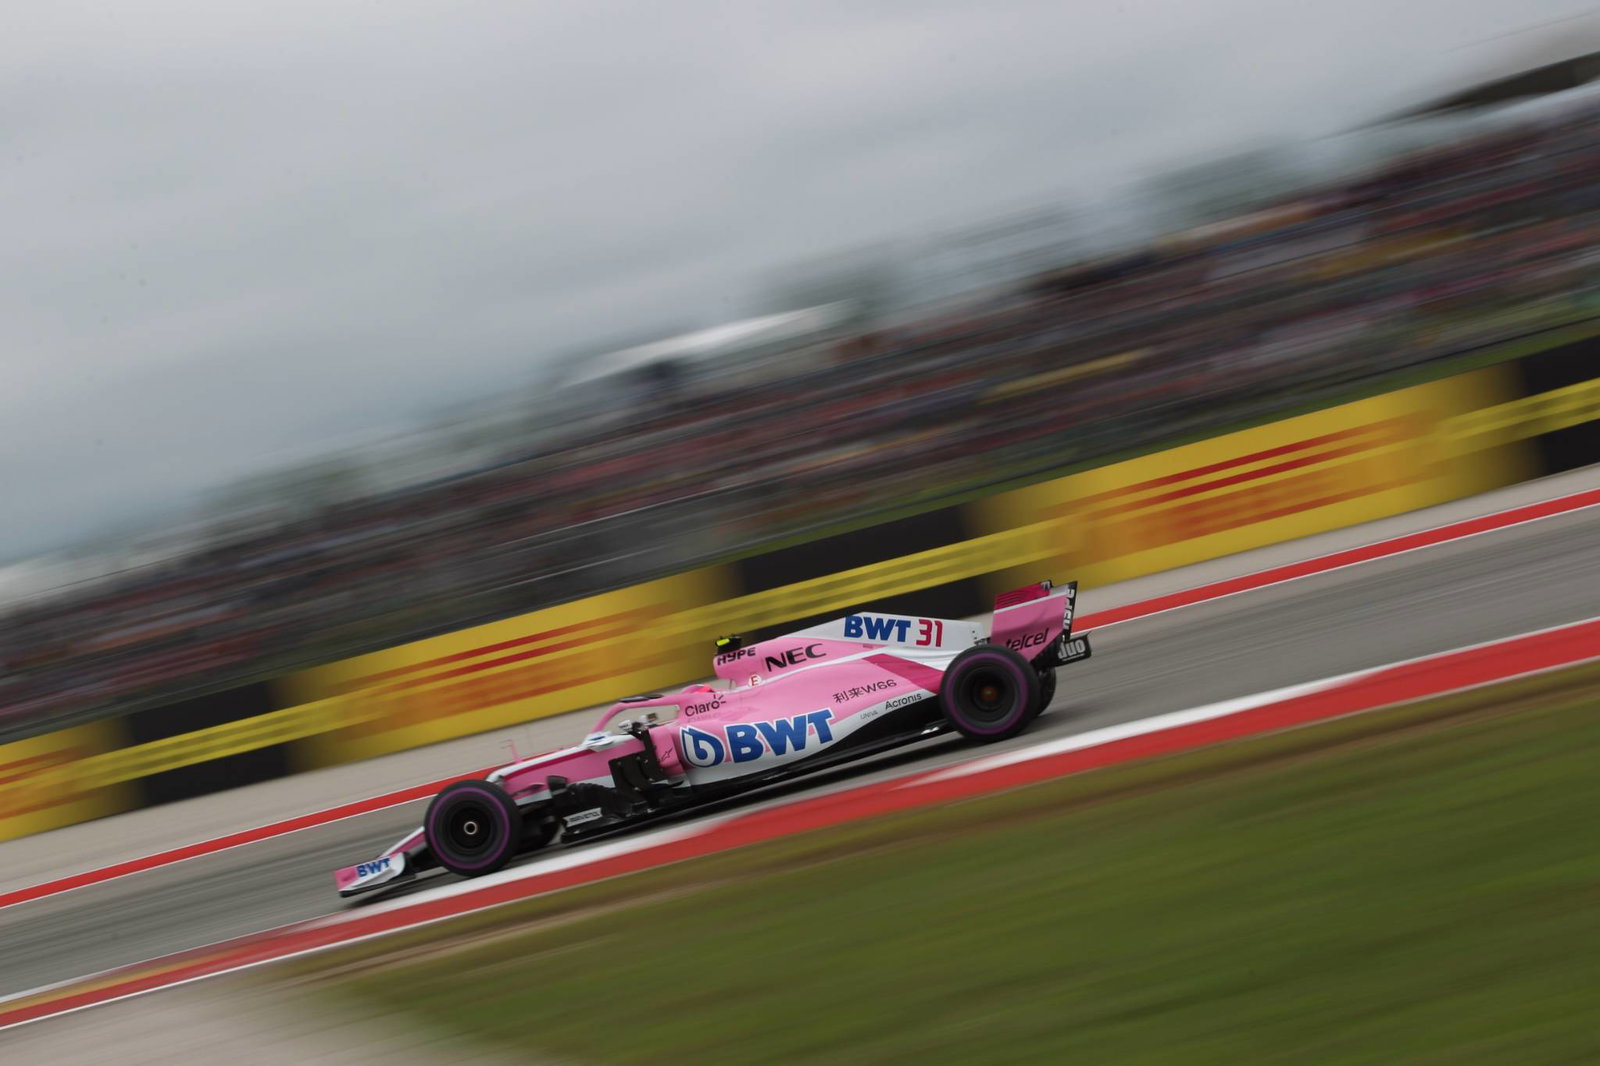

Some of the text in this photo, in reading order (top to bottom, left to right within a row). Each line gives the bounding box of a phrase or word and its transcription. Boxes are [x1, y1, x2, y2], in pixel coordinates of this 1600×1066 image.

[843, 616, 943, 647] BWT 31
[1006, 627, 1049, 651] telcel
[717, 647, 756, 666] HYPE
[765, 643, 827, 672] NEC
[685, 697, 723, 717] Claro
[885, 693, 922, 710] Acronis
[725, 709, 835, 764] BWT
[356, 857, 391, 877] BWT
